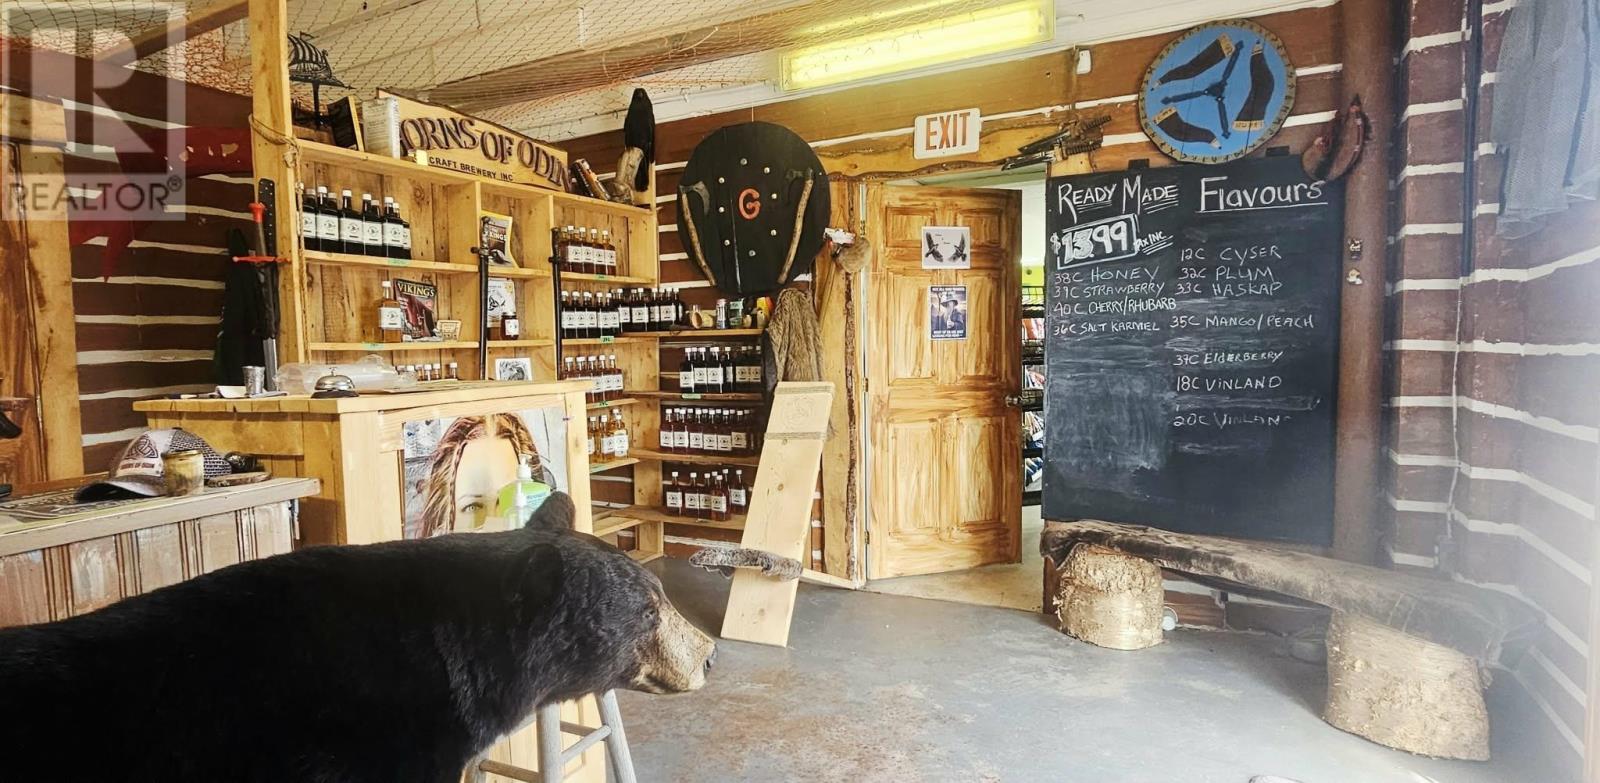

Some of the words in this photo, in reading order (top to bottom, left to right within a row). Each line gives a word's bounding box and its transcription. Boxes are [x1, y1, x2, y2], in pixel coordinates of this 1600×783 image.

[926, 111, 969, 152] EXIT
[480, 130, 514, 164] OF
[429, 156, 457, 169] CRAFT
[460, 163, 496, 179] BREWERY
[501, 172, 514, 181] INC
[1058, 183, 1117, 224] READY
[1122, 175, 1179, 215] MADE
[1200, 176, 1327, 211] Flavours
[738, 187, 761, 220] G
[1181, 248, 1205, 261] 12C
[1219, 245, 1282, 266] CYSER
[1054, 272, 1084, 284] 38C
[1091, 266, 1159, 283] HONEY
[1178, 267, 1206, 280] 32C
[1216, 265, 1274, 282] PLUM
[397, 283, 436, 297] VIKINGS
[1083, 282, 1164, 298] STRAWBERRY
[1174, 282, 1202, 295] 33C
[1212, 281, 1282, 297] HASKAP
[1053, 323, 1077, 335] 36C
[1079, 322, 1107, 335] SALT
[1111, 321, 1160, 333] KARMEL
[1170, 315, 1200, 328] 35C
[1173, 354, 1199, 366] 37C
[1177, 375, 1200, 391] 18C
[1173, 413, 1211, 427] 20C
